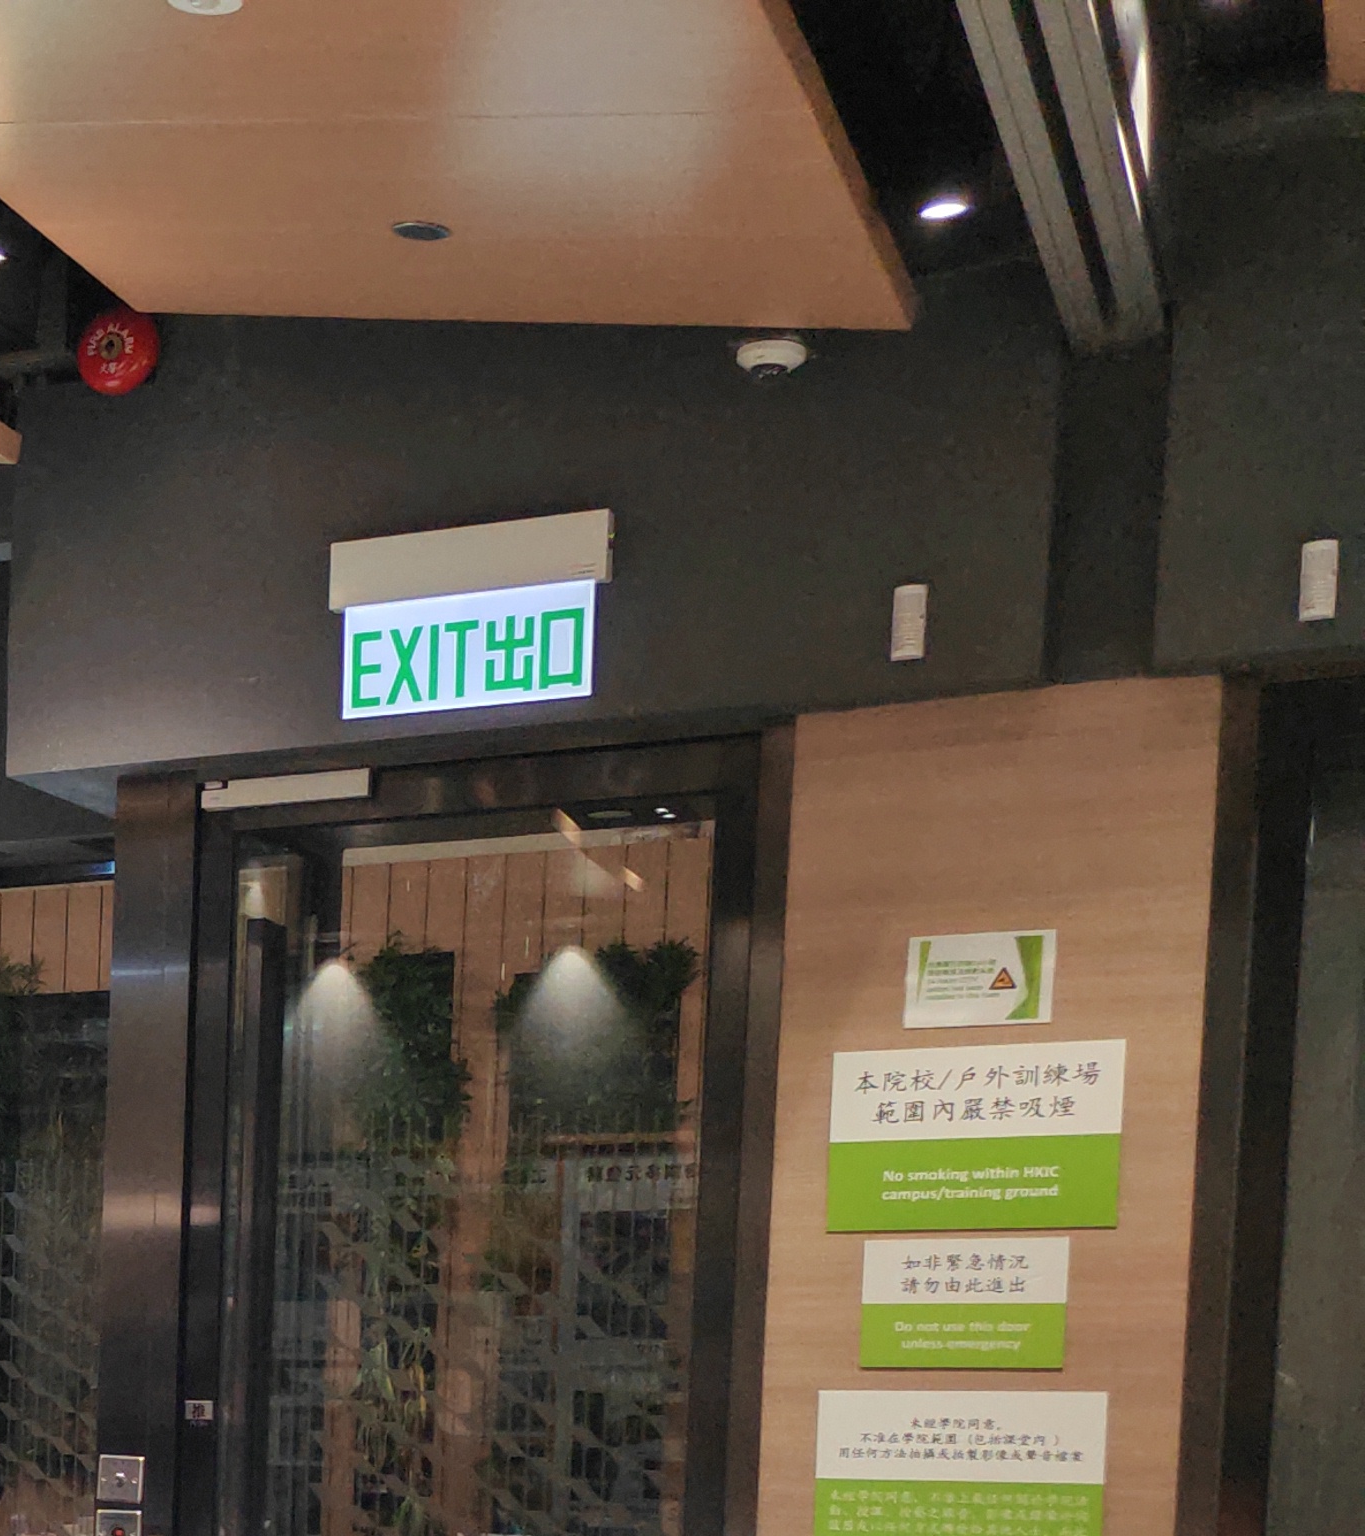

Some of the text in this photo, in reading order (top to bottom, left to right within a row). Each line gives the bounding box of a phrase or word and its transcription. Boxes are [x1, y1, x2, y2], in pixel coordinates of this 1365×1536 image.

[87, 329, 106, 356] FIRE
[351, 608, 585, 709] EXIT 出口
[854, 1061, 1101, 1095] 本院校/戶外訓練場
[872, 1095, 1076, 1124] 範圍內嚴禁吸煙
[883, 1165, 1060, 1184] No smoking within HKIC
[881, 1184, 1059, 1202] campus/training ground
[901, 1253, 1029, 1271] 如非緊急情況
[900, 1276, 1027, 1294] 請勿由此進出
[894, 1321, 912, 1332] Do
[917, 1322, 939, 1332] not
[943, 1322, 965, 1332] use
[997, 1321, 1031, 1332] door
[901, 1338, 1022, 1351] unless emergency
